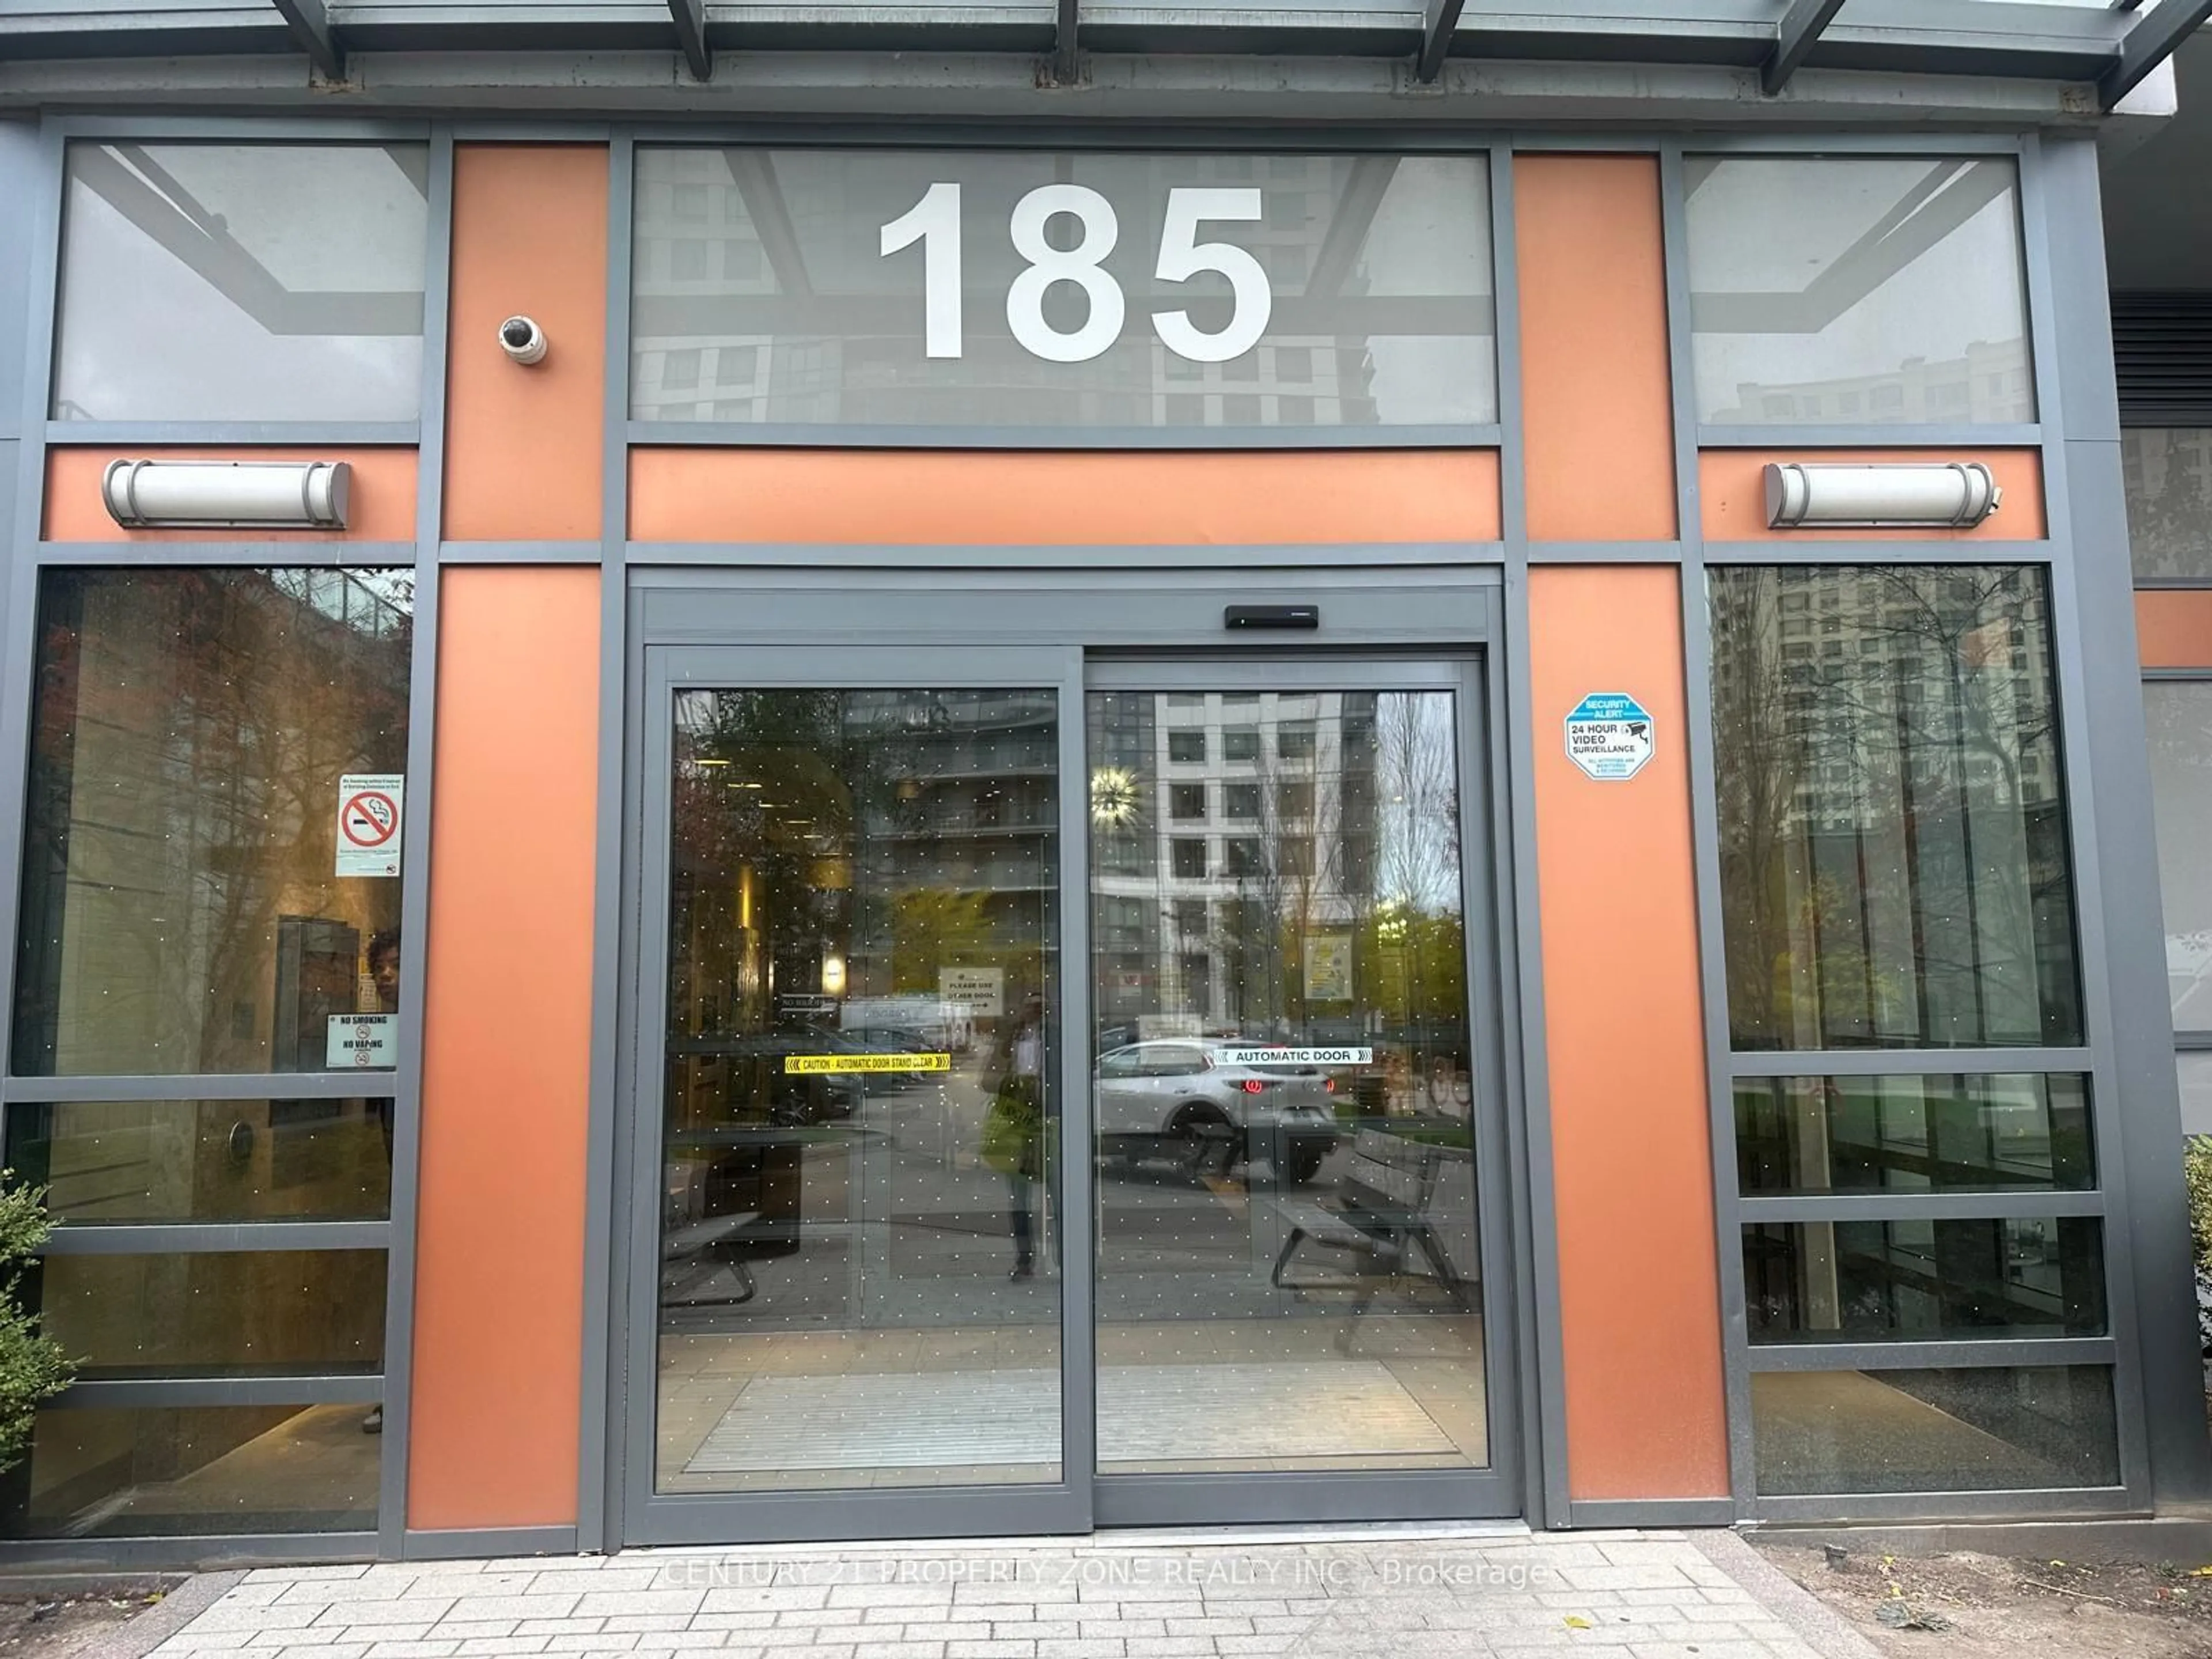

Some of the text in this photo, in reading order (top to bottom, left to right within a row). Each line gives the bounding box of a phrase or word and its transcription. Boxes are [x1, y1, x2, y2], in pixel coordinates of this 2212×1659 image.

[880, 182, 1272, 362] 185
[1585, 700, 1630, 709] SECURITY
[1594, 710, 1623, 718] ALERT
[1571, 724, 1618, 734] 24 HOUR
[1572, 735, 1606, 744] VIDEO
[1573, 745, 1635, 754] SURVEILLANCE
[340, 1016, 388, 1025] NO SMOKING
[343, 1040, 354, 1048] NO
[1236, 1051, 1350, 1062] AUTOMATIC DOOR
[803, 1059, 830, 1070] CAUTION
[836, 1058, 872, 1069] AUTOMATIC
[872, 1058, 890, 1069] DOOR
[891, 1058, 912, 1068] STAND
